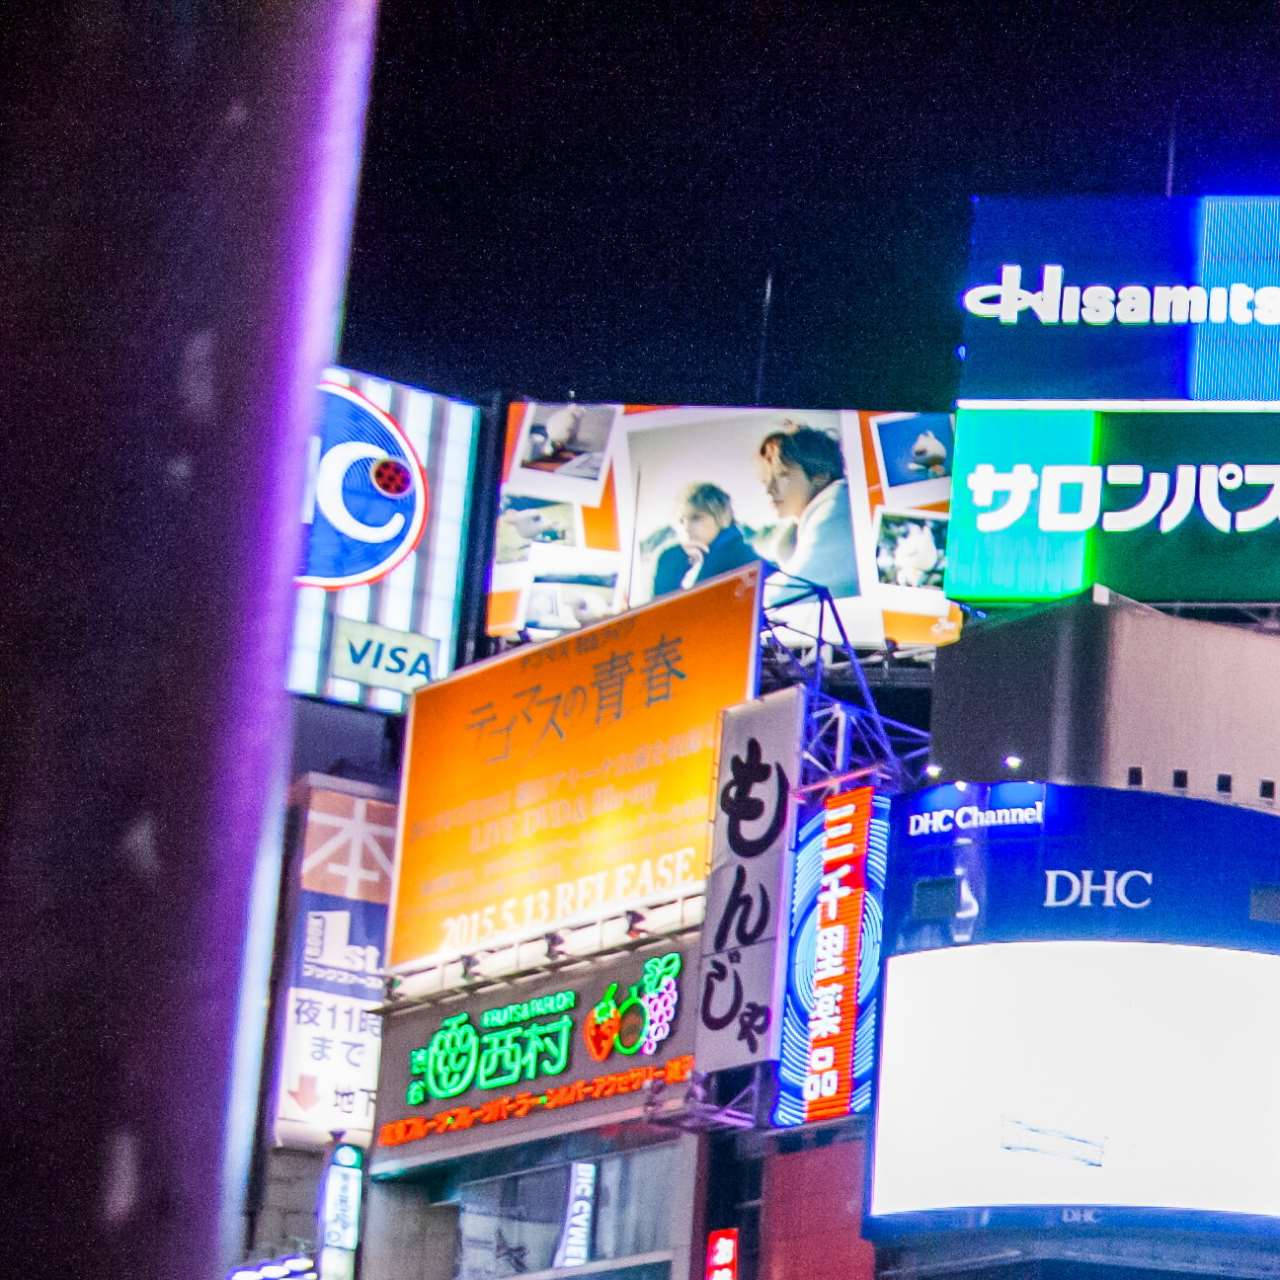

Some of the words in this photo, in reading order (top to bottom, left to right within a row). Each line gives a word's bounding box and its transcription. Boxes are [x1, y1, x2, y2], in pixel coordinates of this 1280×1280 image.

[348, 638, 433, 682] VISA
[908, 808, 954, 836] DHC
[955, 801, 1044, 829] Channel
[301, 798, 398, 899] 本
[701, 737, 791, 1053] もんじゃ
[1042, 869, 1153, 909] DHC
[310, 1036, 366, 1068] まで
[478, 1014, 574, 1090] 西村
